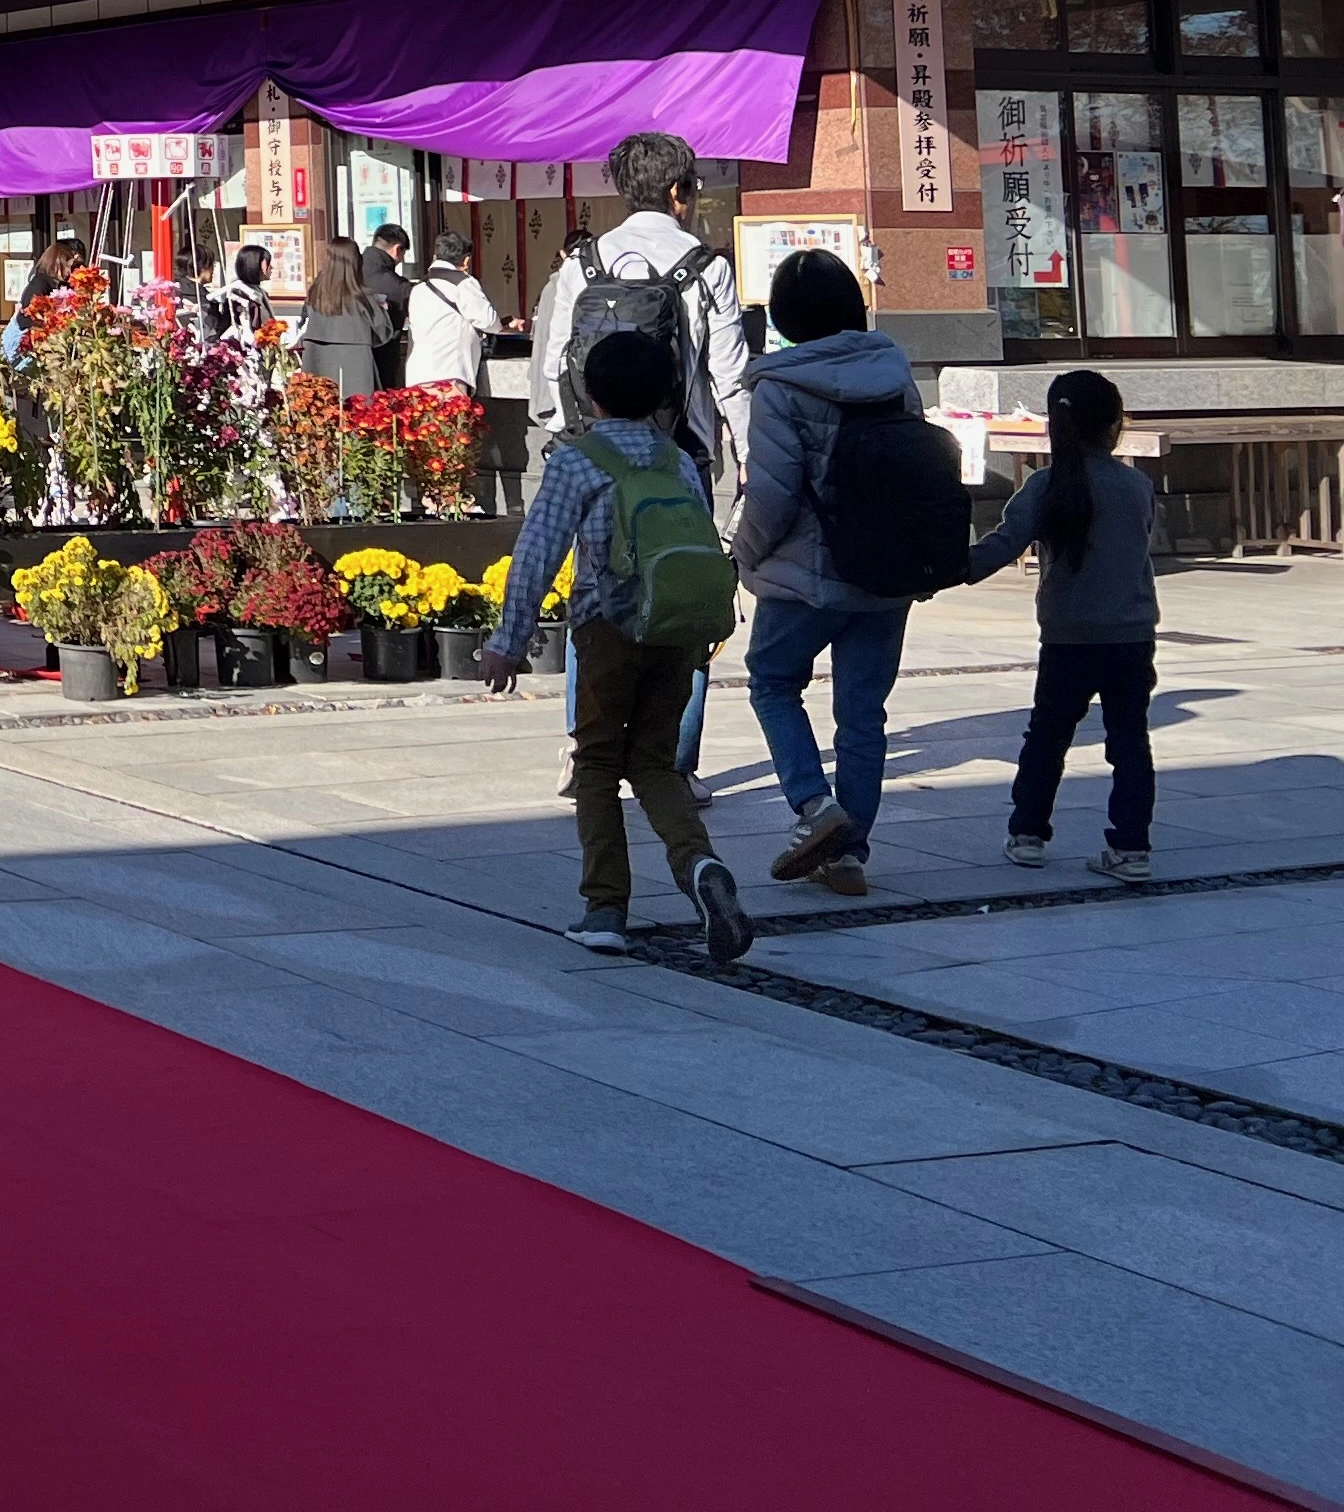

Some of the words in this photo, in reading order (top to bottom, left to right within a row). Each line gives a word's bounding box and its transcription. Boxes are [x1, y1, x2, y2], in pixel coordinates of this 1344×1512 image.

[265, 76, 284, 218] 札・御守授与所
[997, 96, 1034, 277] 御祈願受付
